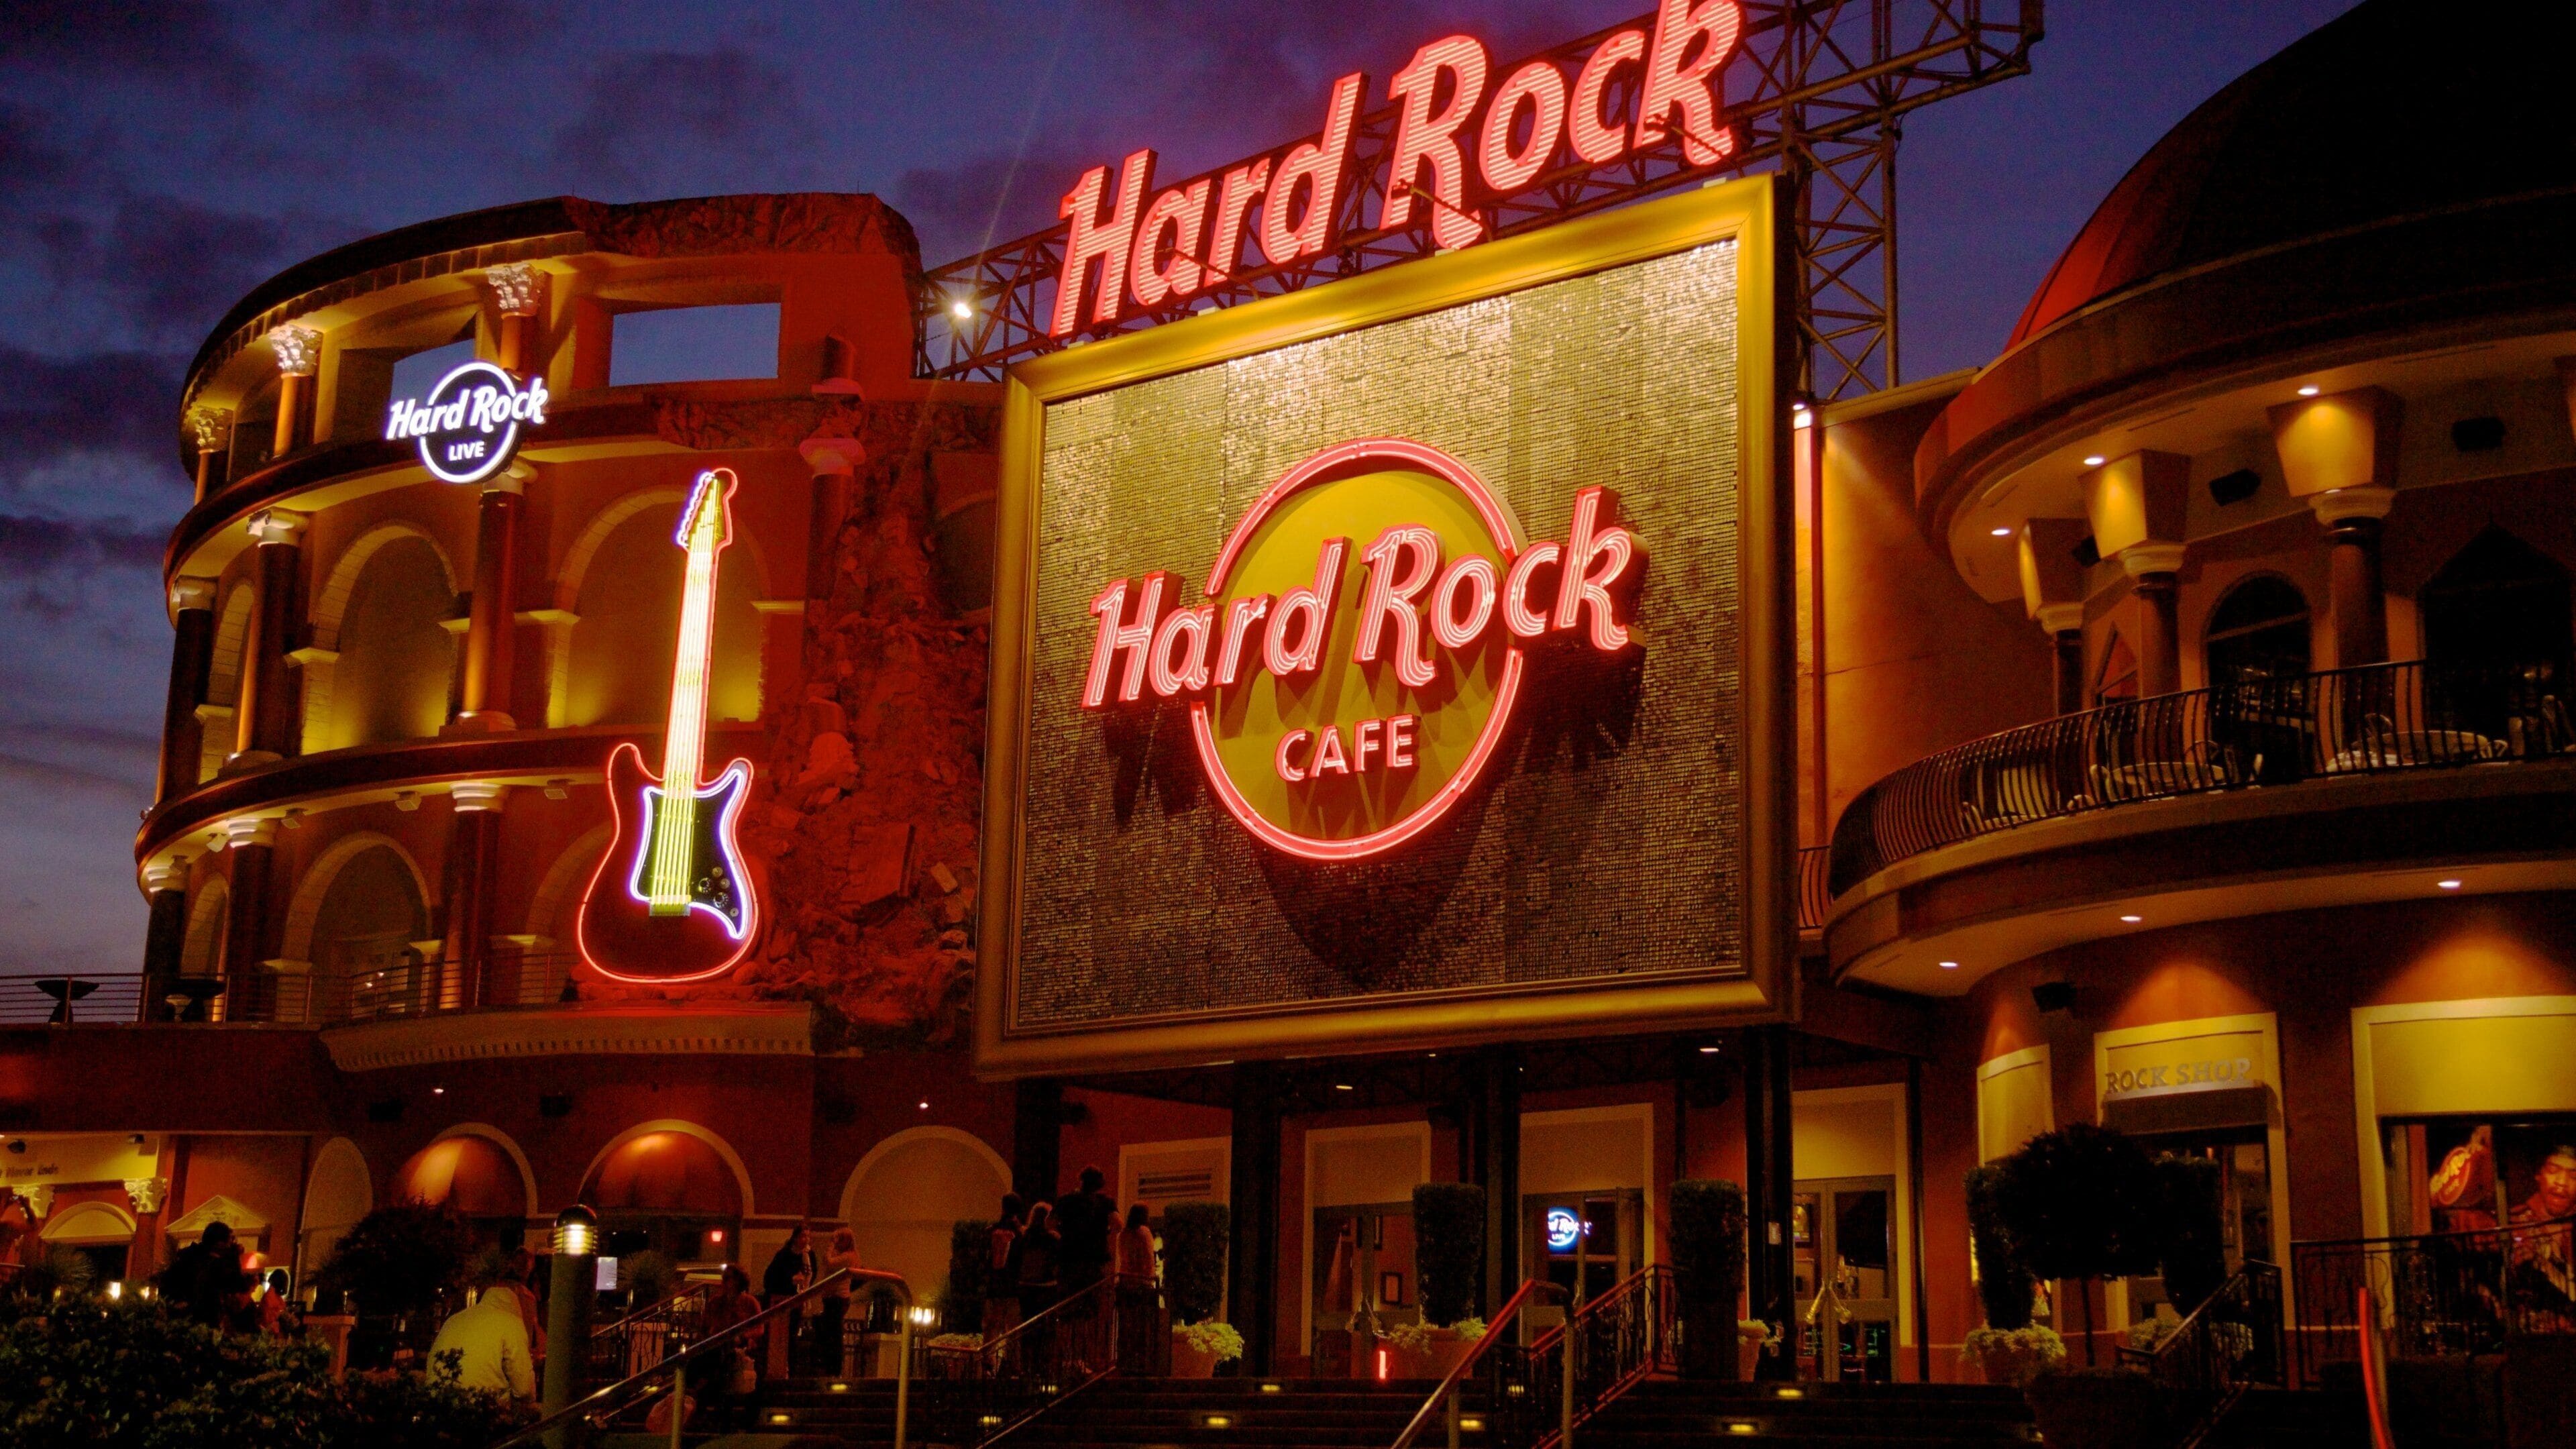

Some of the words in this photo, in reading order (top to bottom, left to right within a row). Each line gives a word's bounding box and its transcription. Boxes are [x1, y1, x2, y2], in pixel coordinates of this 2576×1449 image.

[1049, 72, 1370, 338] Hard
[1379, 0, 1744, 251] Rock
[386, 389, 470, 440] Hard
[470, 378, 549, 433] Rock
[448, 441, 484, 461] LIVE
[1081, 537, 1348, 710] Hard
[1352, 484, 1638, 688] Rock
[1275, 714, 1418, 782] CAFE
[2105, 1065, 2169, 1094] ROCK
[2176, 1057, 2251, 1085] SHOP
